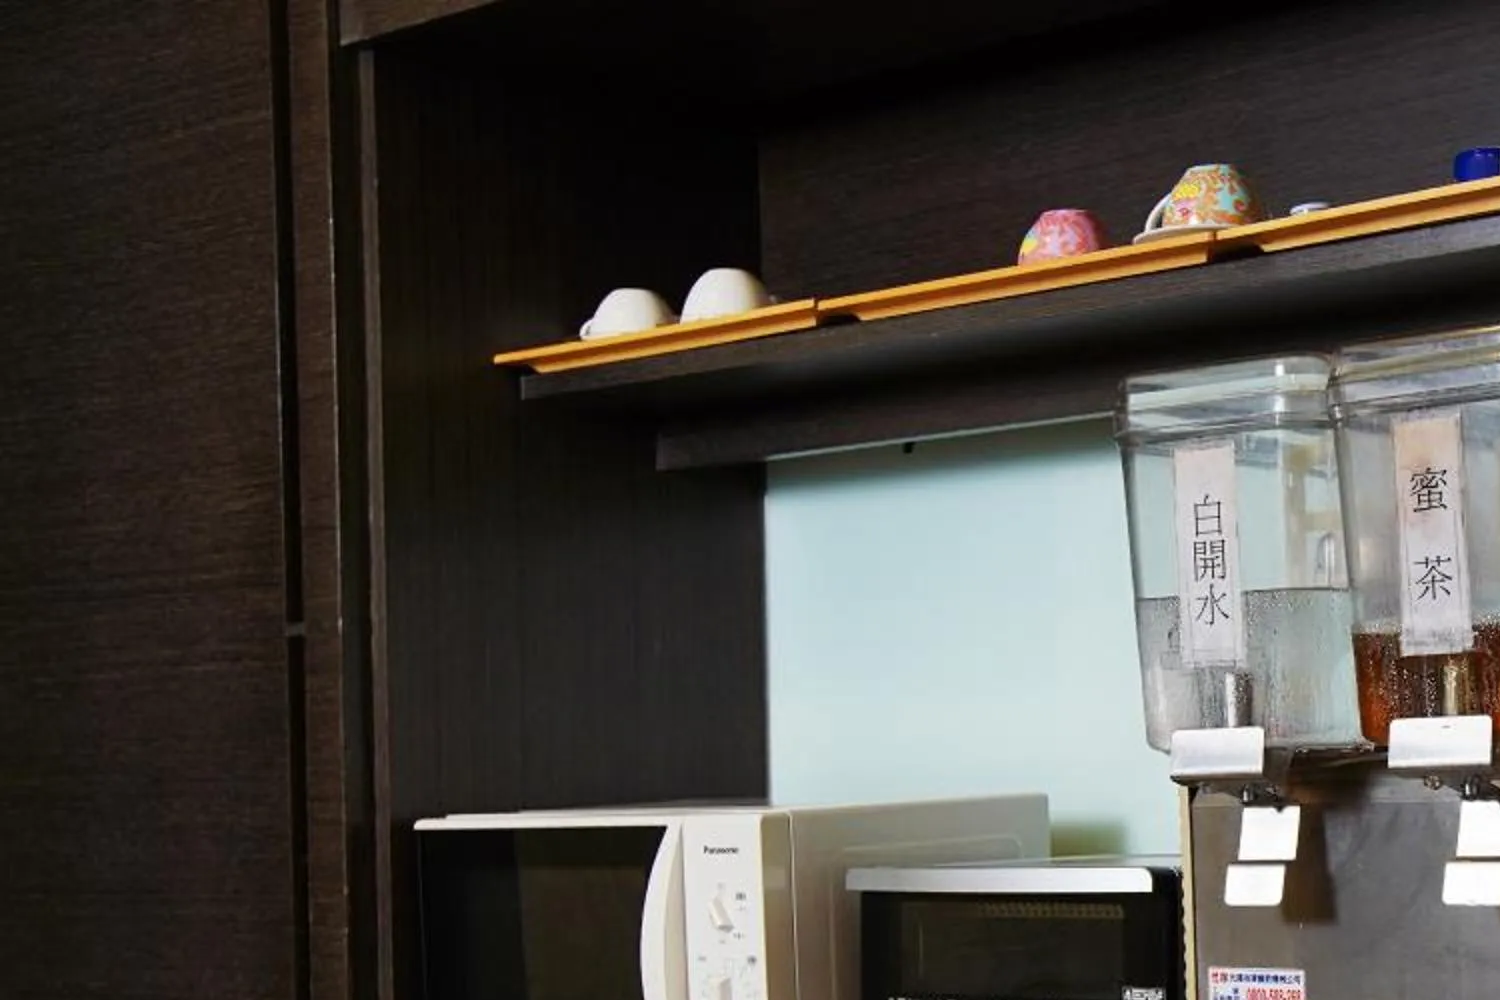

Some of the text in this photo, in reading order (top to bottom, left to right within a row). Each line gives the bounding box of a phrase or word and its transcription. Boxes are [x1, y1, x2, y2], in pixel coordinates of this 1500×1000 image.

[1193, 494, 1230, 626] 白開水
[1409, 467, 1453, 601] 蜜茶
[703, 845, 739, 855] Panasonic
